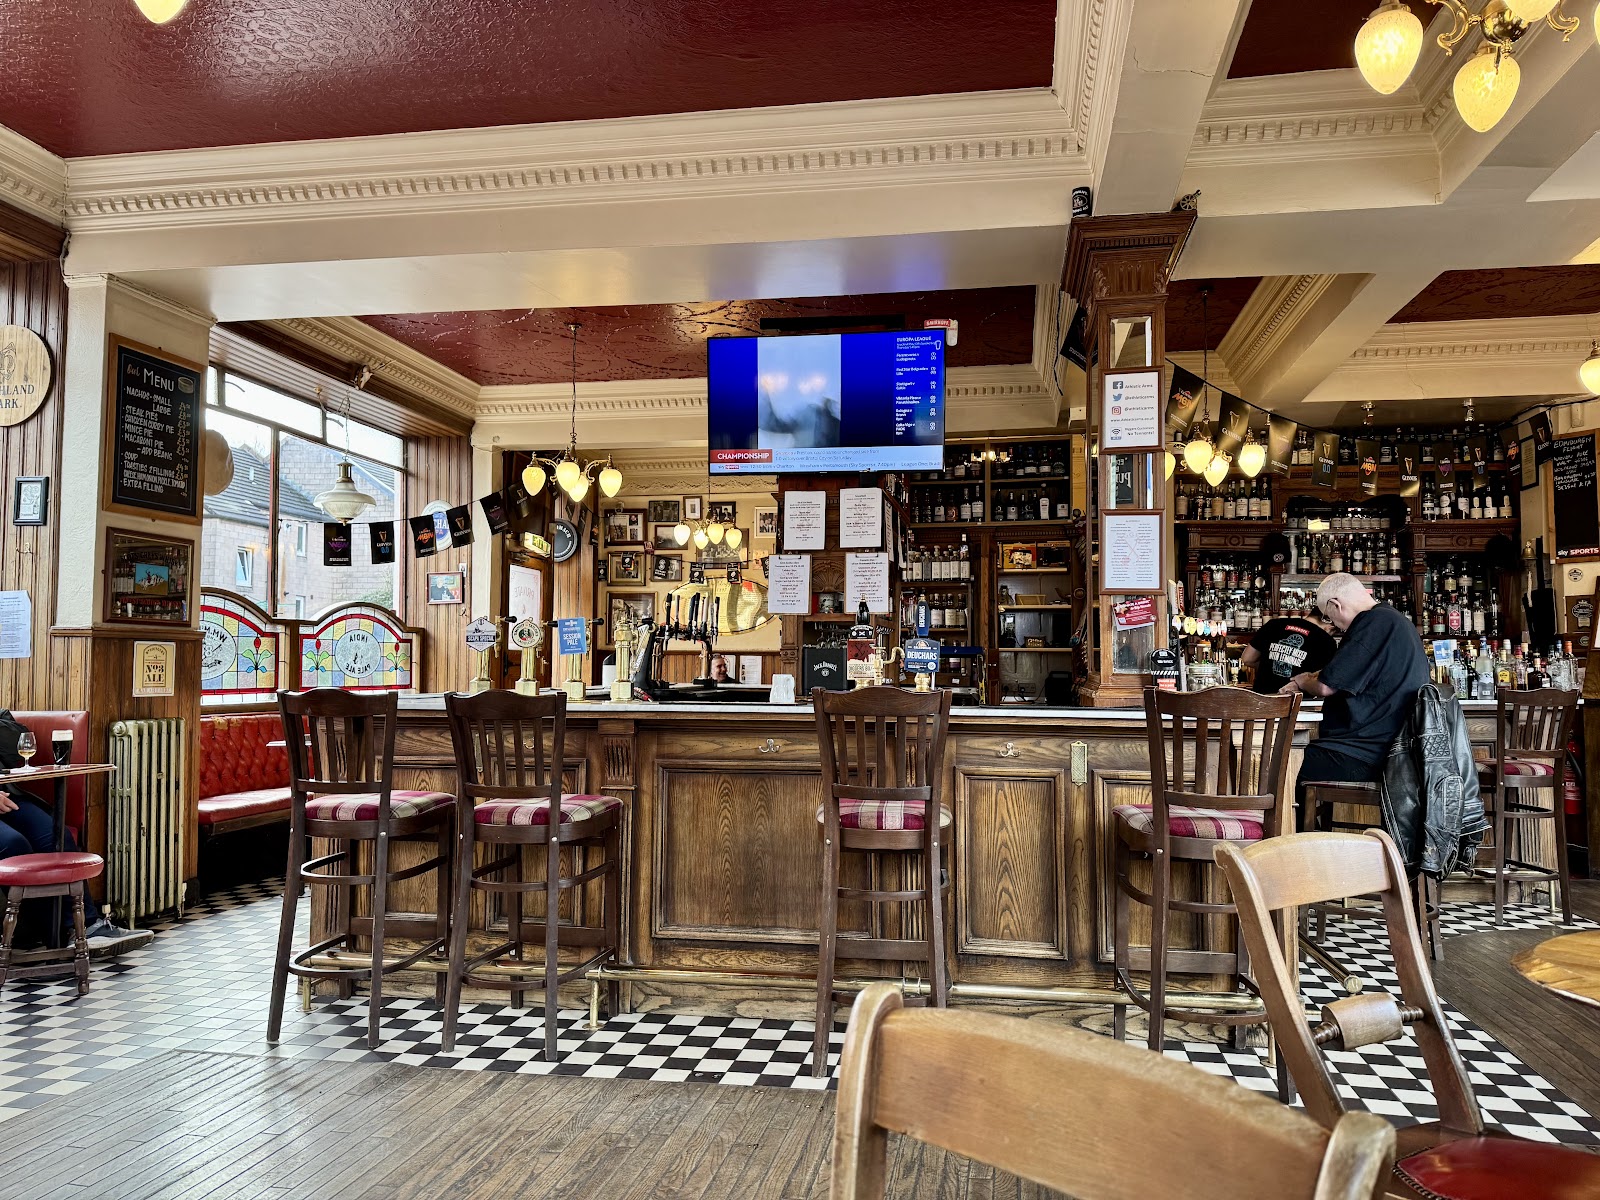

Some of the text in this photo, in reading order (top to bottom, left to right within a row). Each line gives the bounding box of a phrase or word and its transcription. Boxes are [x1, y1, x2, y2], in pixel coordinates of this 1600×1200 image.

[143, 368, 174, 391] MENU
[125, 423, 153, 438] MINCE PIE
[166, 425, 174, 434] PIE
[154, 440, 164, 450] PIE
[124, 451, 138, 461] SOUP
[153, 449, 172, 460] BEANS
[123, 478, 142, 490] EXTRA
[907, 651, 937, 660] DEUCHARS
[145, 674, 164, 682] ALE
